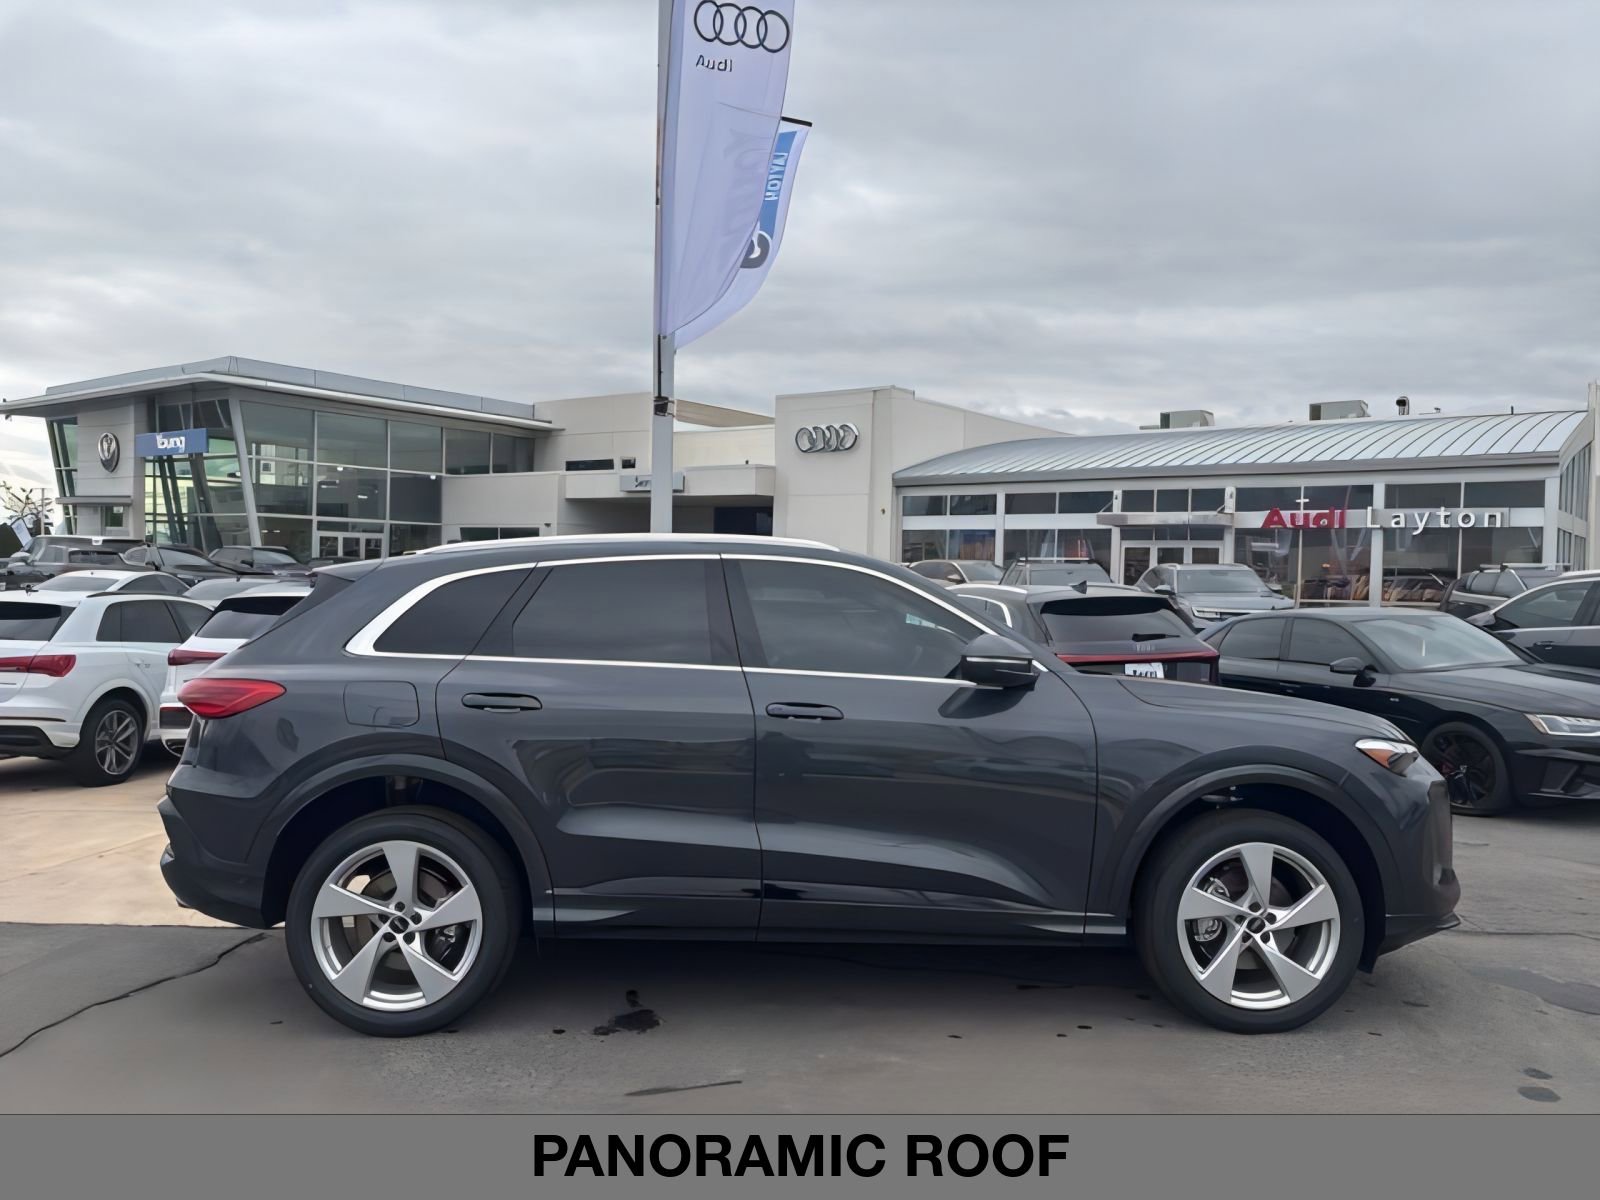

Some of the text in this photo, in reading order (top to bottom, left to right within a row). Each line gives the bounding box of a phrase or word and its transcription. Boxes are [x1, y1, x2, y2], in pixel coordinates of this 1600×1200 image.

[696, 54, 732, 72] Audi
[1261, 506, 1502, 535] Audi Layton
